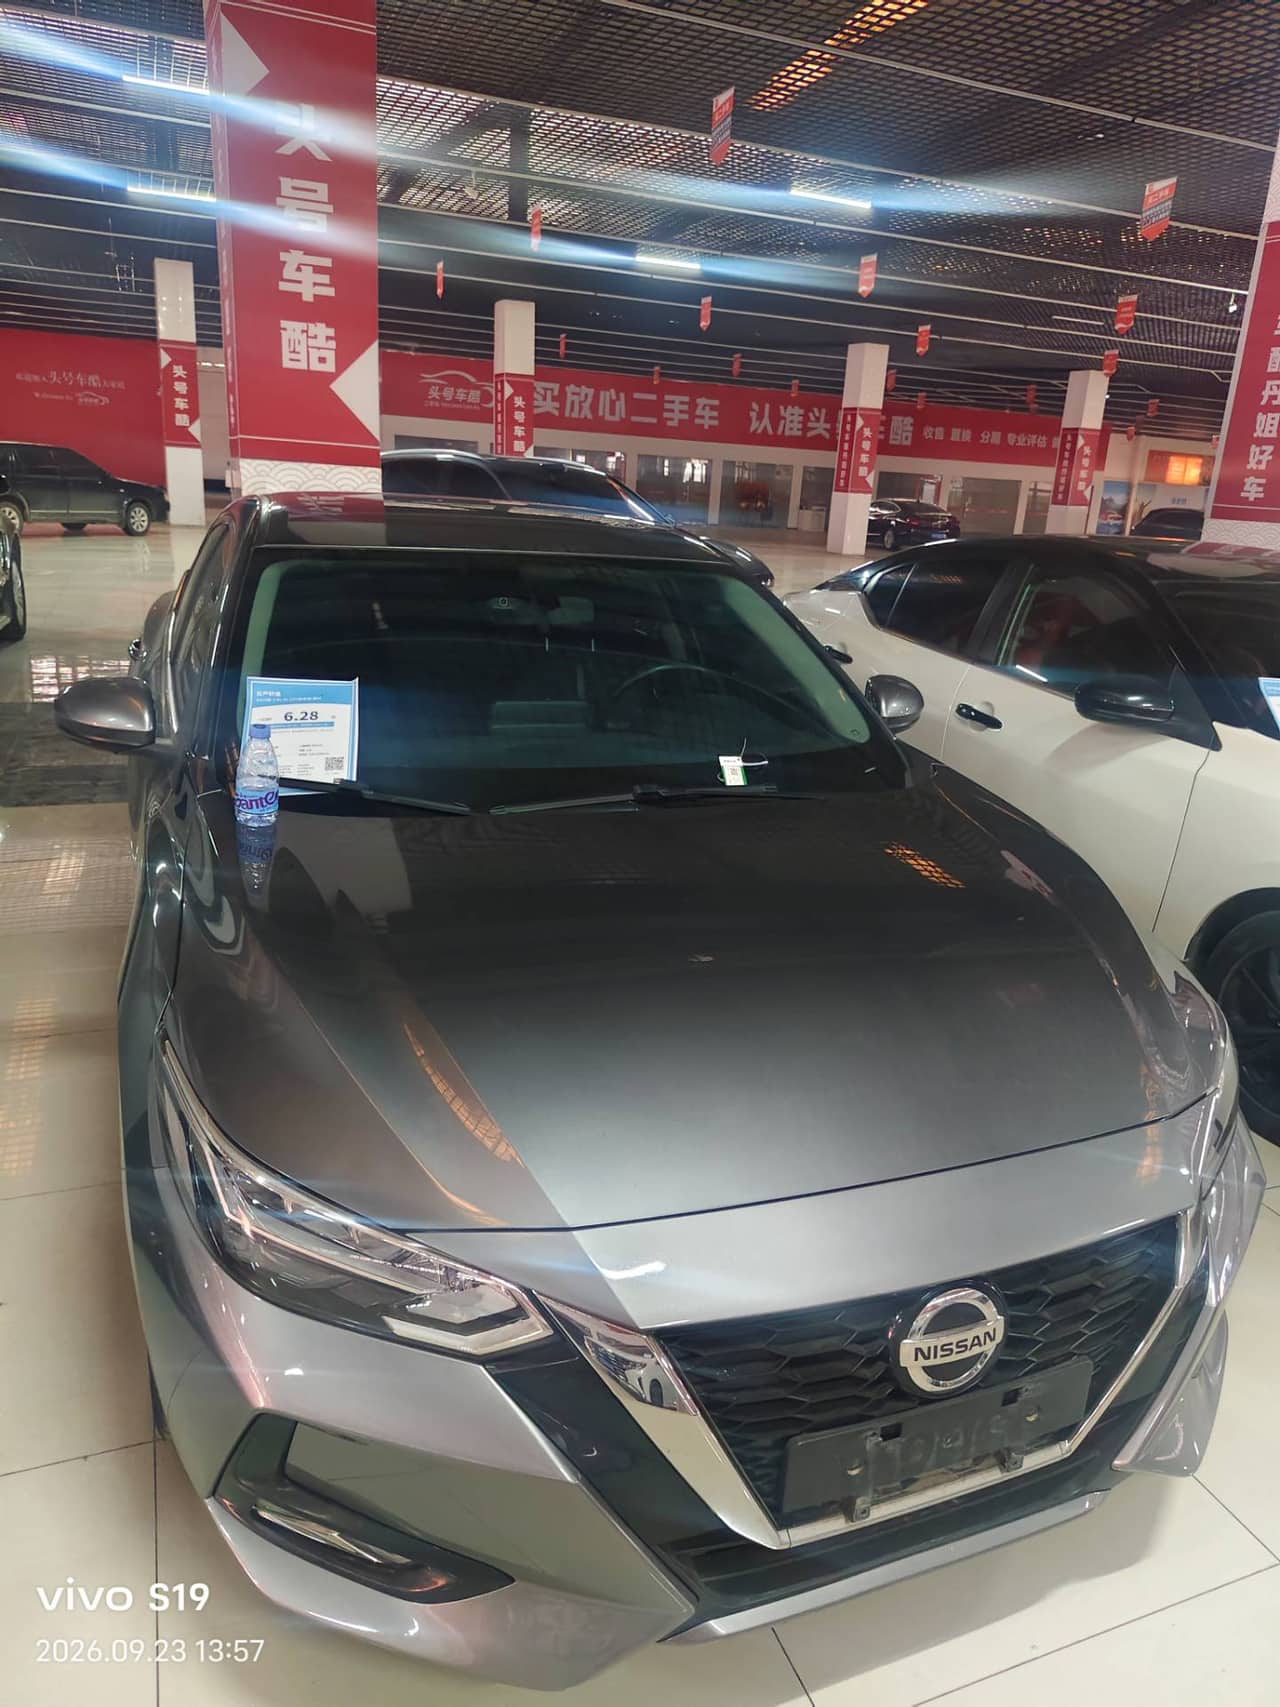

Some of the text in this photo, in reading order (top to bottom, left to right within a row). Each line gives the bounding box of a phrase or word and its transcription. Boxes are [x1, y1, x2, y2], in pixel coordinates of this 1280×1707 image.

[275, 103, 336, 373] 头号车酷
[533, 381, 720, 429] 买放心二手车
[749, 402, 914, 446] 认准头酷
[284, 711, 319, 722] 6.28
[914, 1328, 996, 1361] NISSAN
